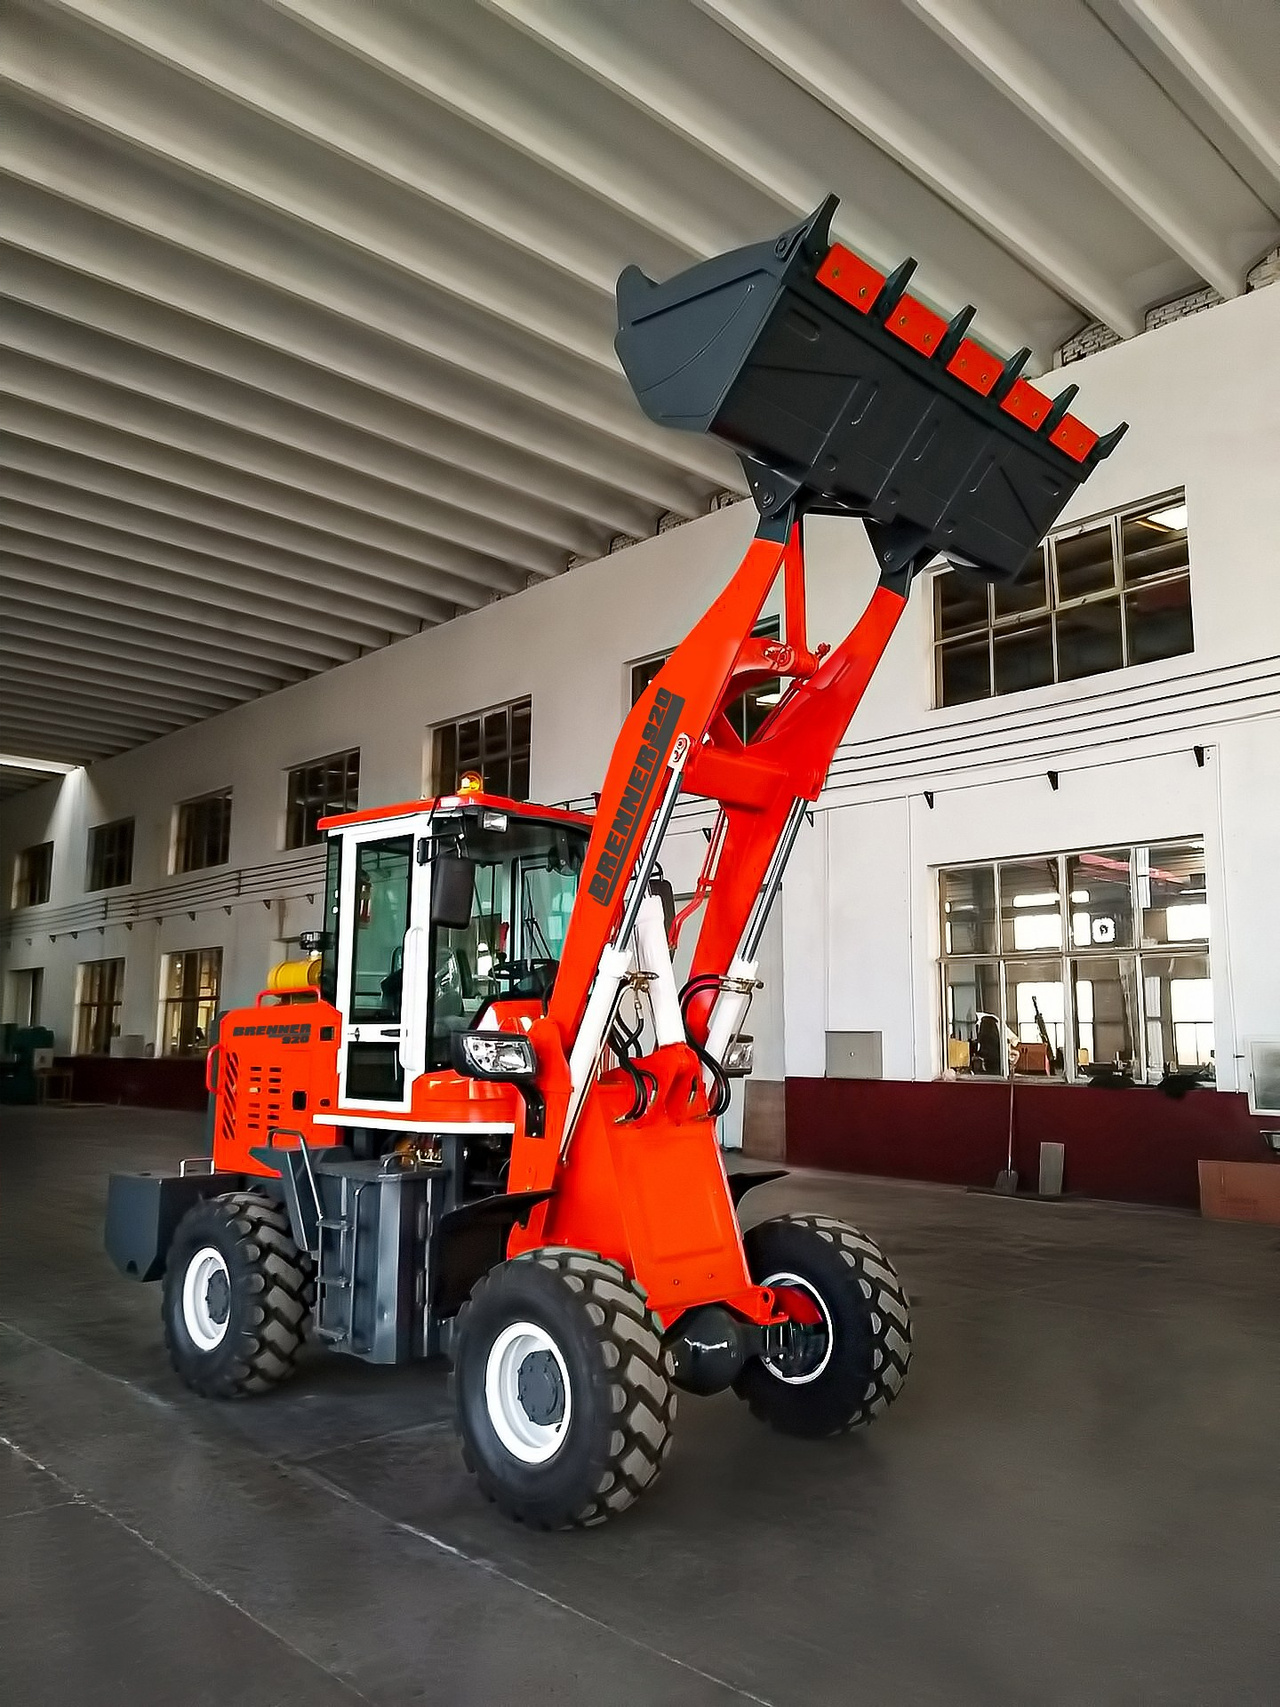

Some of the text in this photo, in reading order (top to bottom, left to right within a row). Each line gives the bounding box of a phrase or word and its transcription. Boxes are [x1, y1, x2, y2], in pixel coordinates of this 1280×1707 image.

[587, 687, 673, 901] BRENNER 920
[233, 1024, 311, 1036] BRENNER
[282, 1035, 310, 1044] 920
